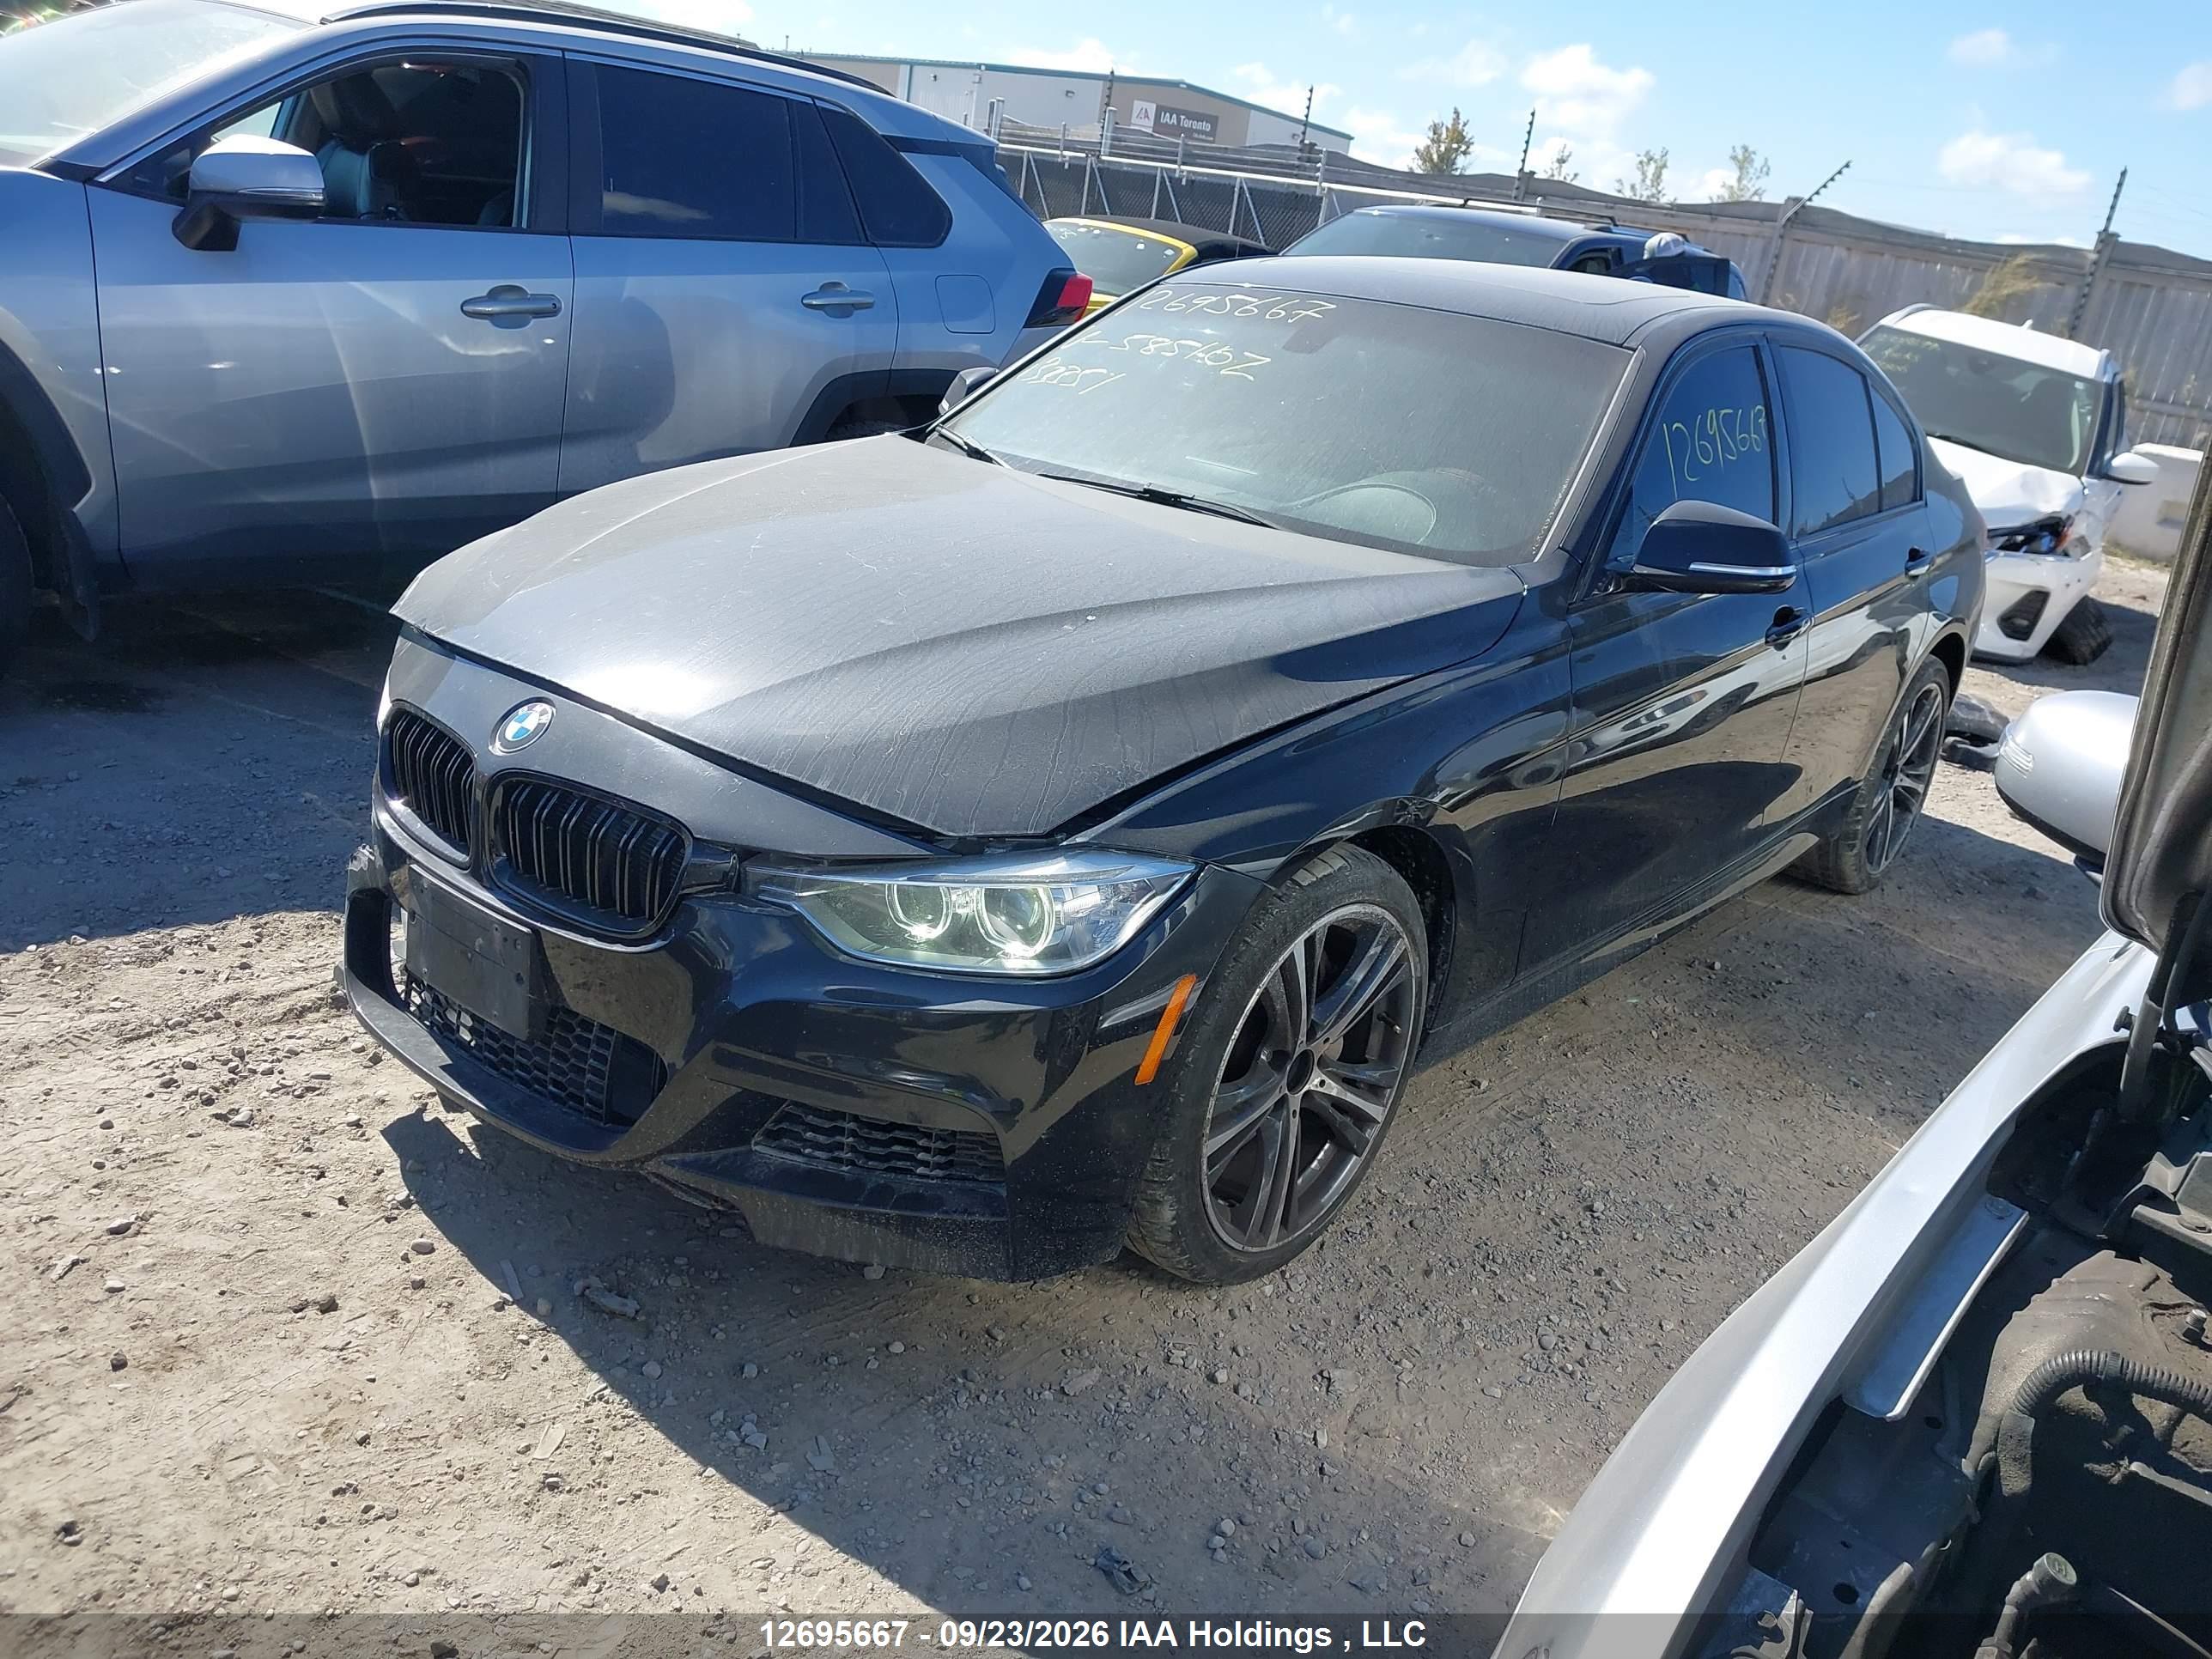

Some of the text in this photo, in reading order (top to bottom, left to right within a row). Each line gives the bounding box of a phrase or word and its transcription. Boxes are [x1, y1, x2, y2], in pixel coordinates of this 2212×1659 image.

[1160, 111, 1177, 125] IAA
[1180, 115, 1211, 131] Toronto
[1115, 289, 1338, 323] 12695667
[1662, 404, 1767, 501] 12695667
